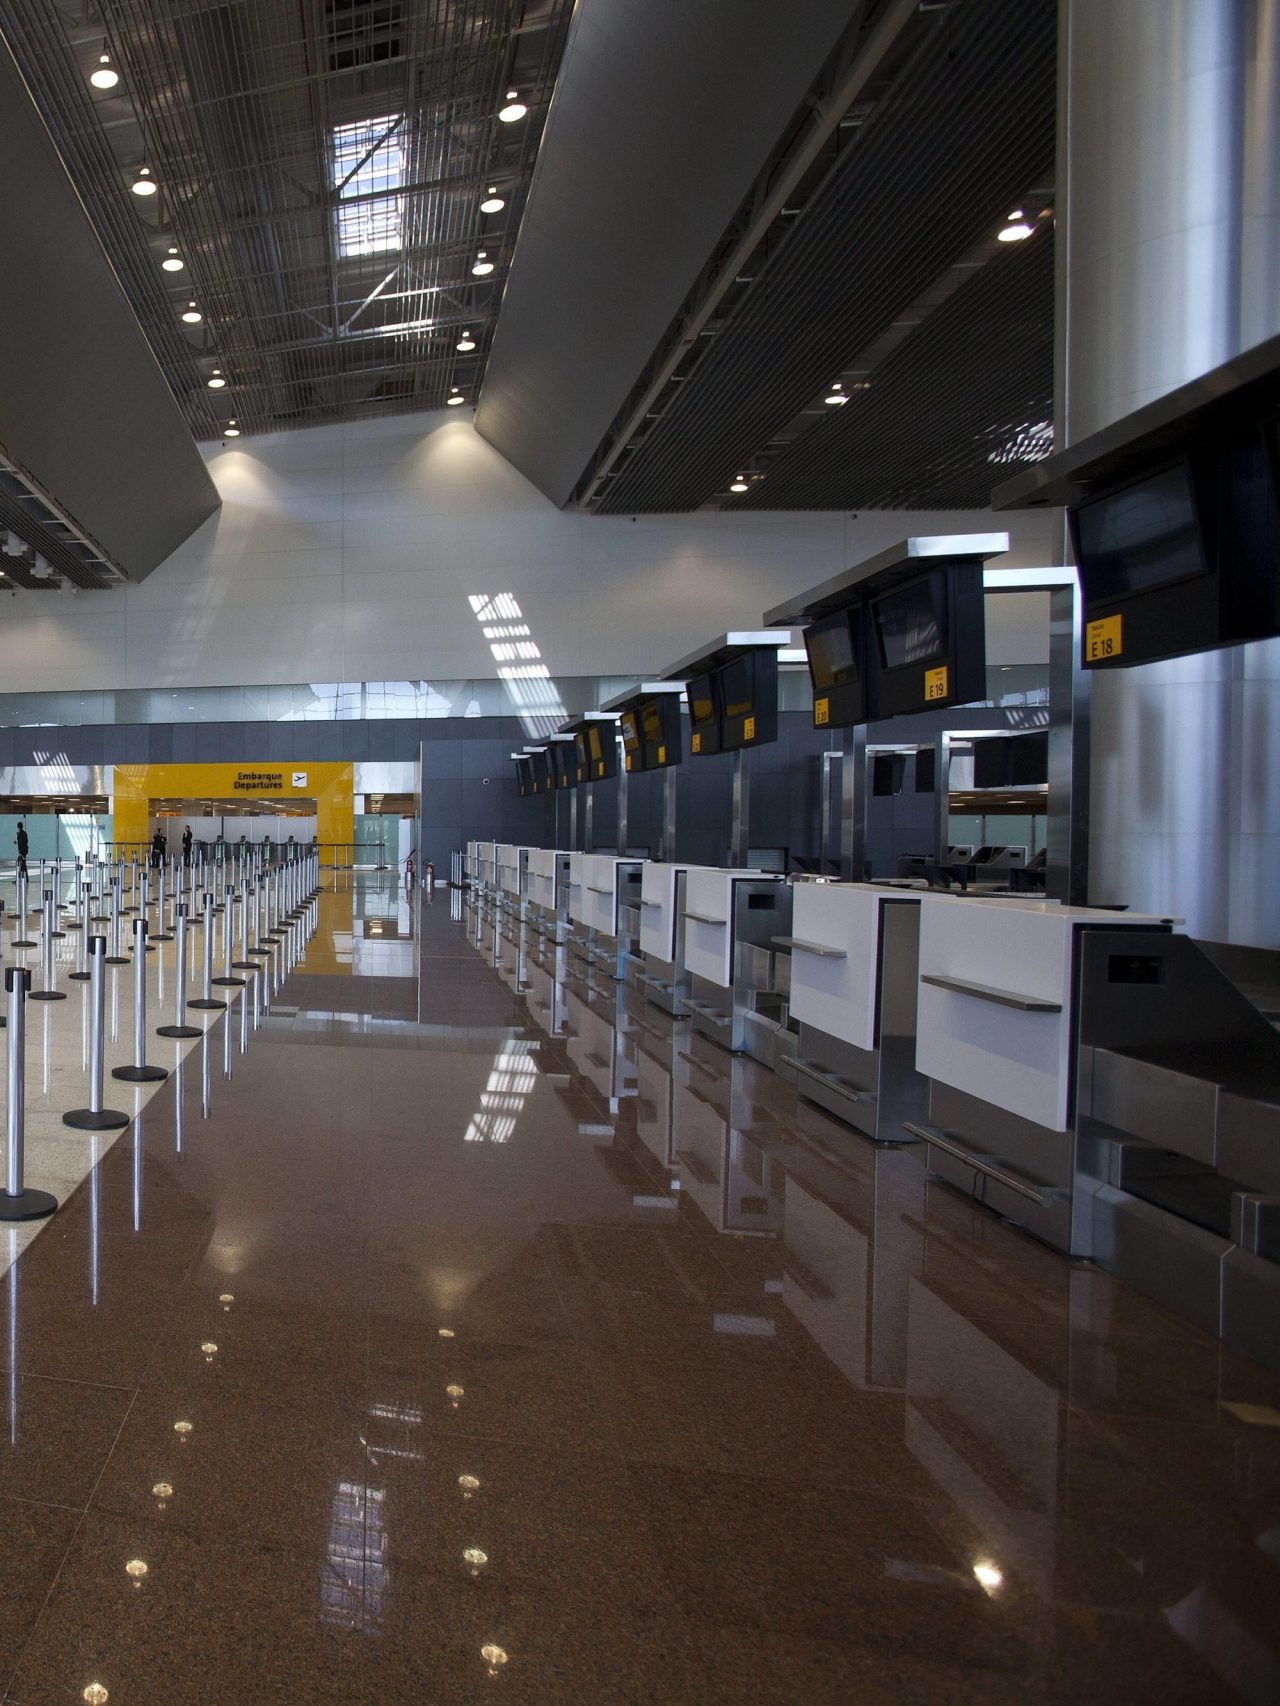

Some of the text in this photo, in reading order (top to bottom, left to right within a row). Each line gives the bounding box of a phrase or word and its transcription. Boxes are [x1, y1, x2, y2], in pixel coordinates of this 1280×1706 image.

[1091, 638, 1113, 657] E 18
[929, 682, 944, 698] E 19
[238, 772, 283, 782] Embarque
[234, 781, 283, 791] Departures
